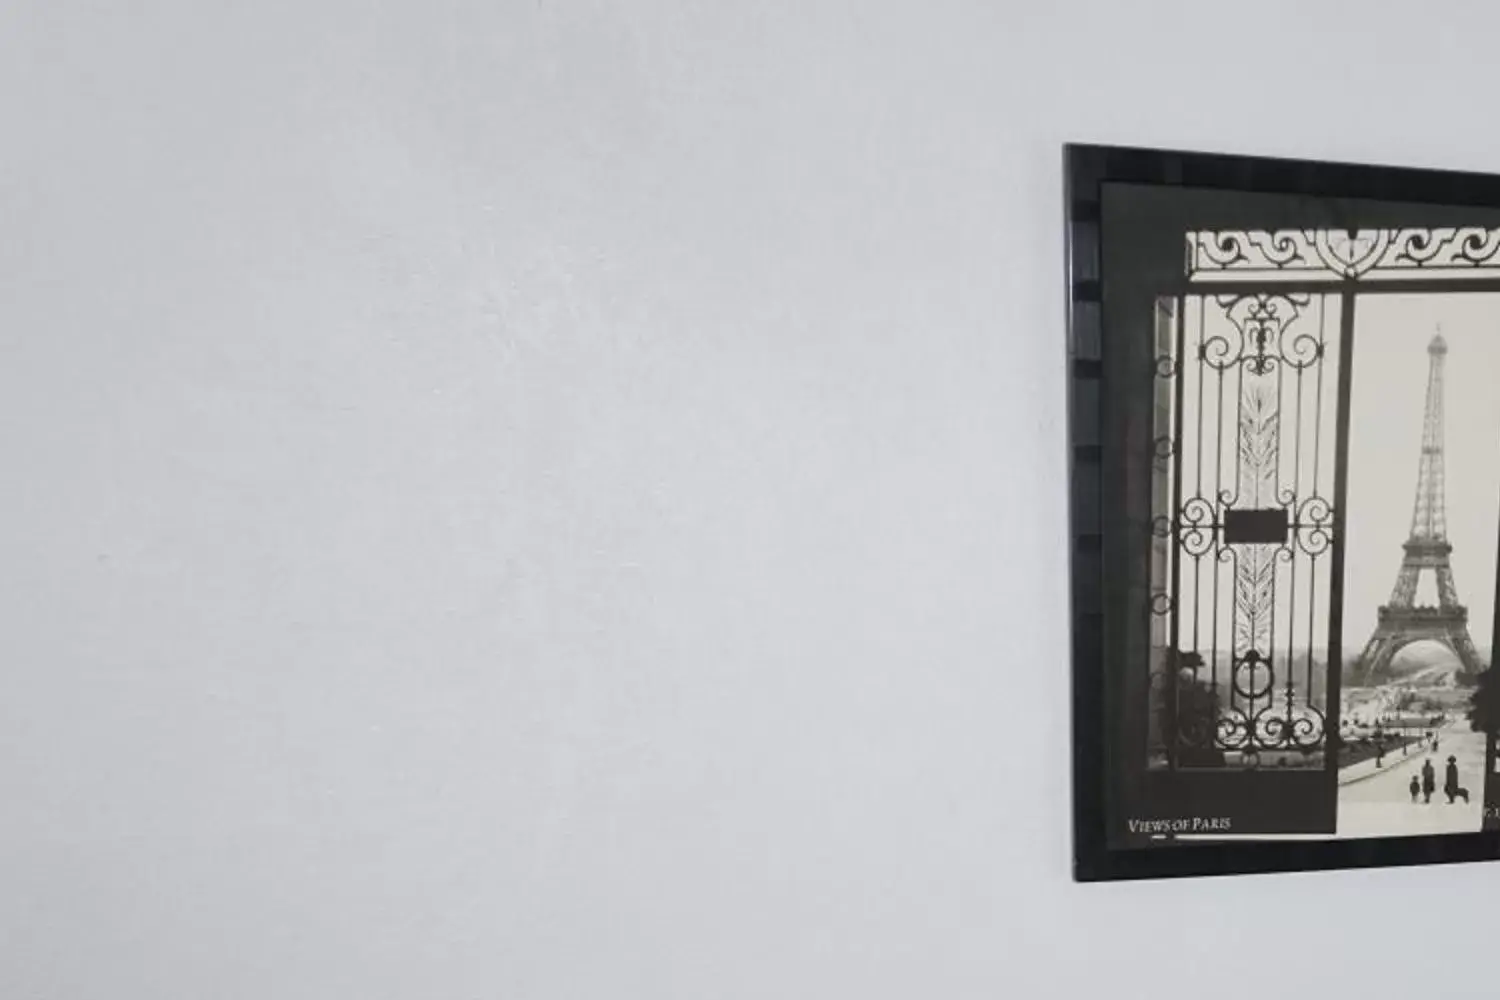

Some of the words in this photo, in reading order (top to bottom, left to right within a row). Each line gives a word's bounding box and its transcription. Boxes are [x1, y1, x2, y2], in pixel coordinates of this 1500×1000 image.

[1128, 818, 1171, 832] VIEWS
[1172, 818, 1190, 831] OF
[1193, 816, 1231, 831] PARIS
